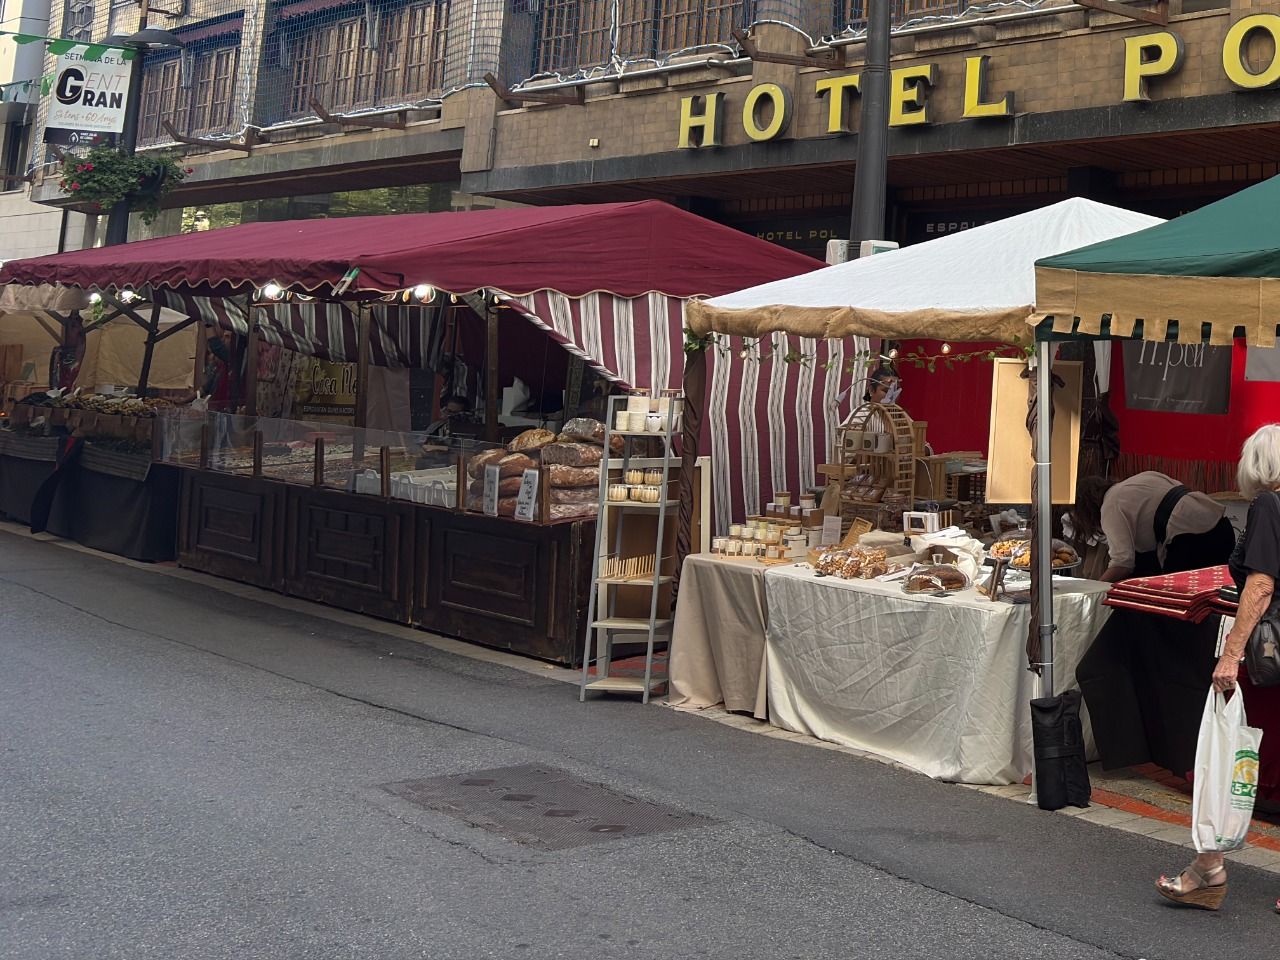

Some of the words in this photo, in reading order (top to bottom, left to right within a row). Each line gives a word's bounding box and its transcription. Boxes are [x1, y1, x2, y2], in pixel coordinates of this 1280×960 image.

[104, 56, 115, 65] DE
[116, 58, 127, 66] LA
[677, 55, 1014, 150] HOTEL
[756, 231, 803, 241] HOTEL
[809, 229, 838, 240] POL
